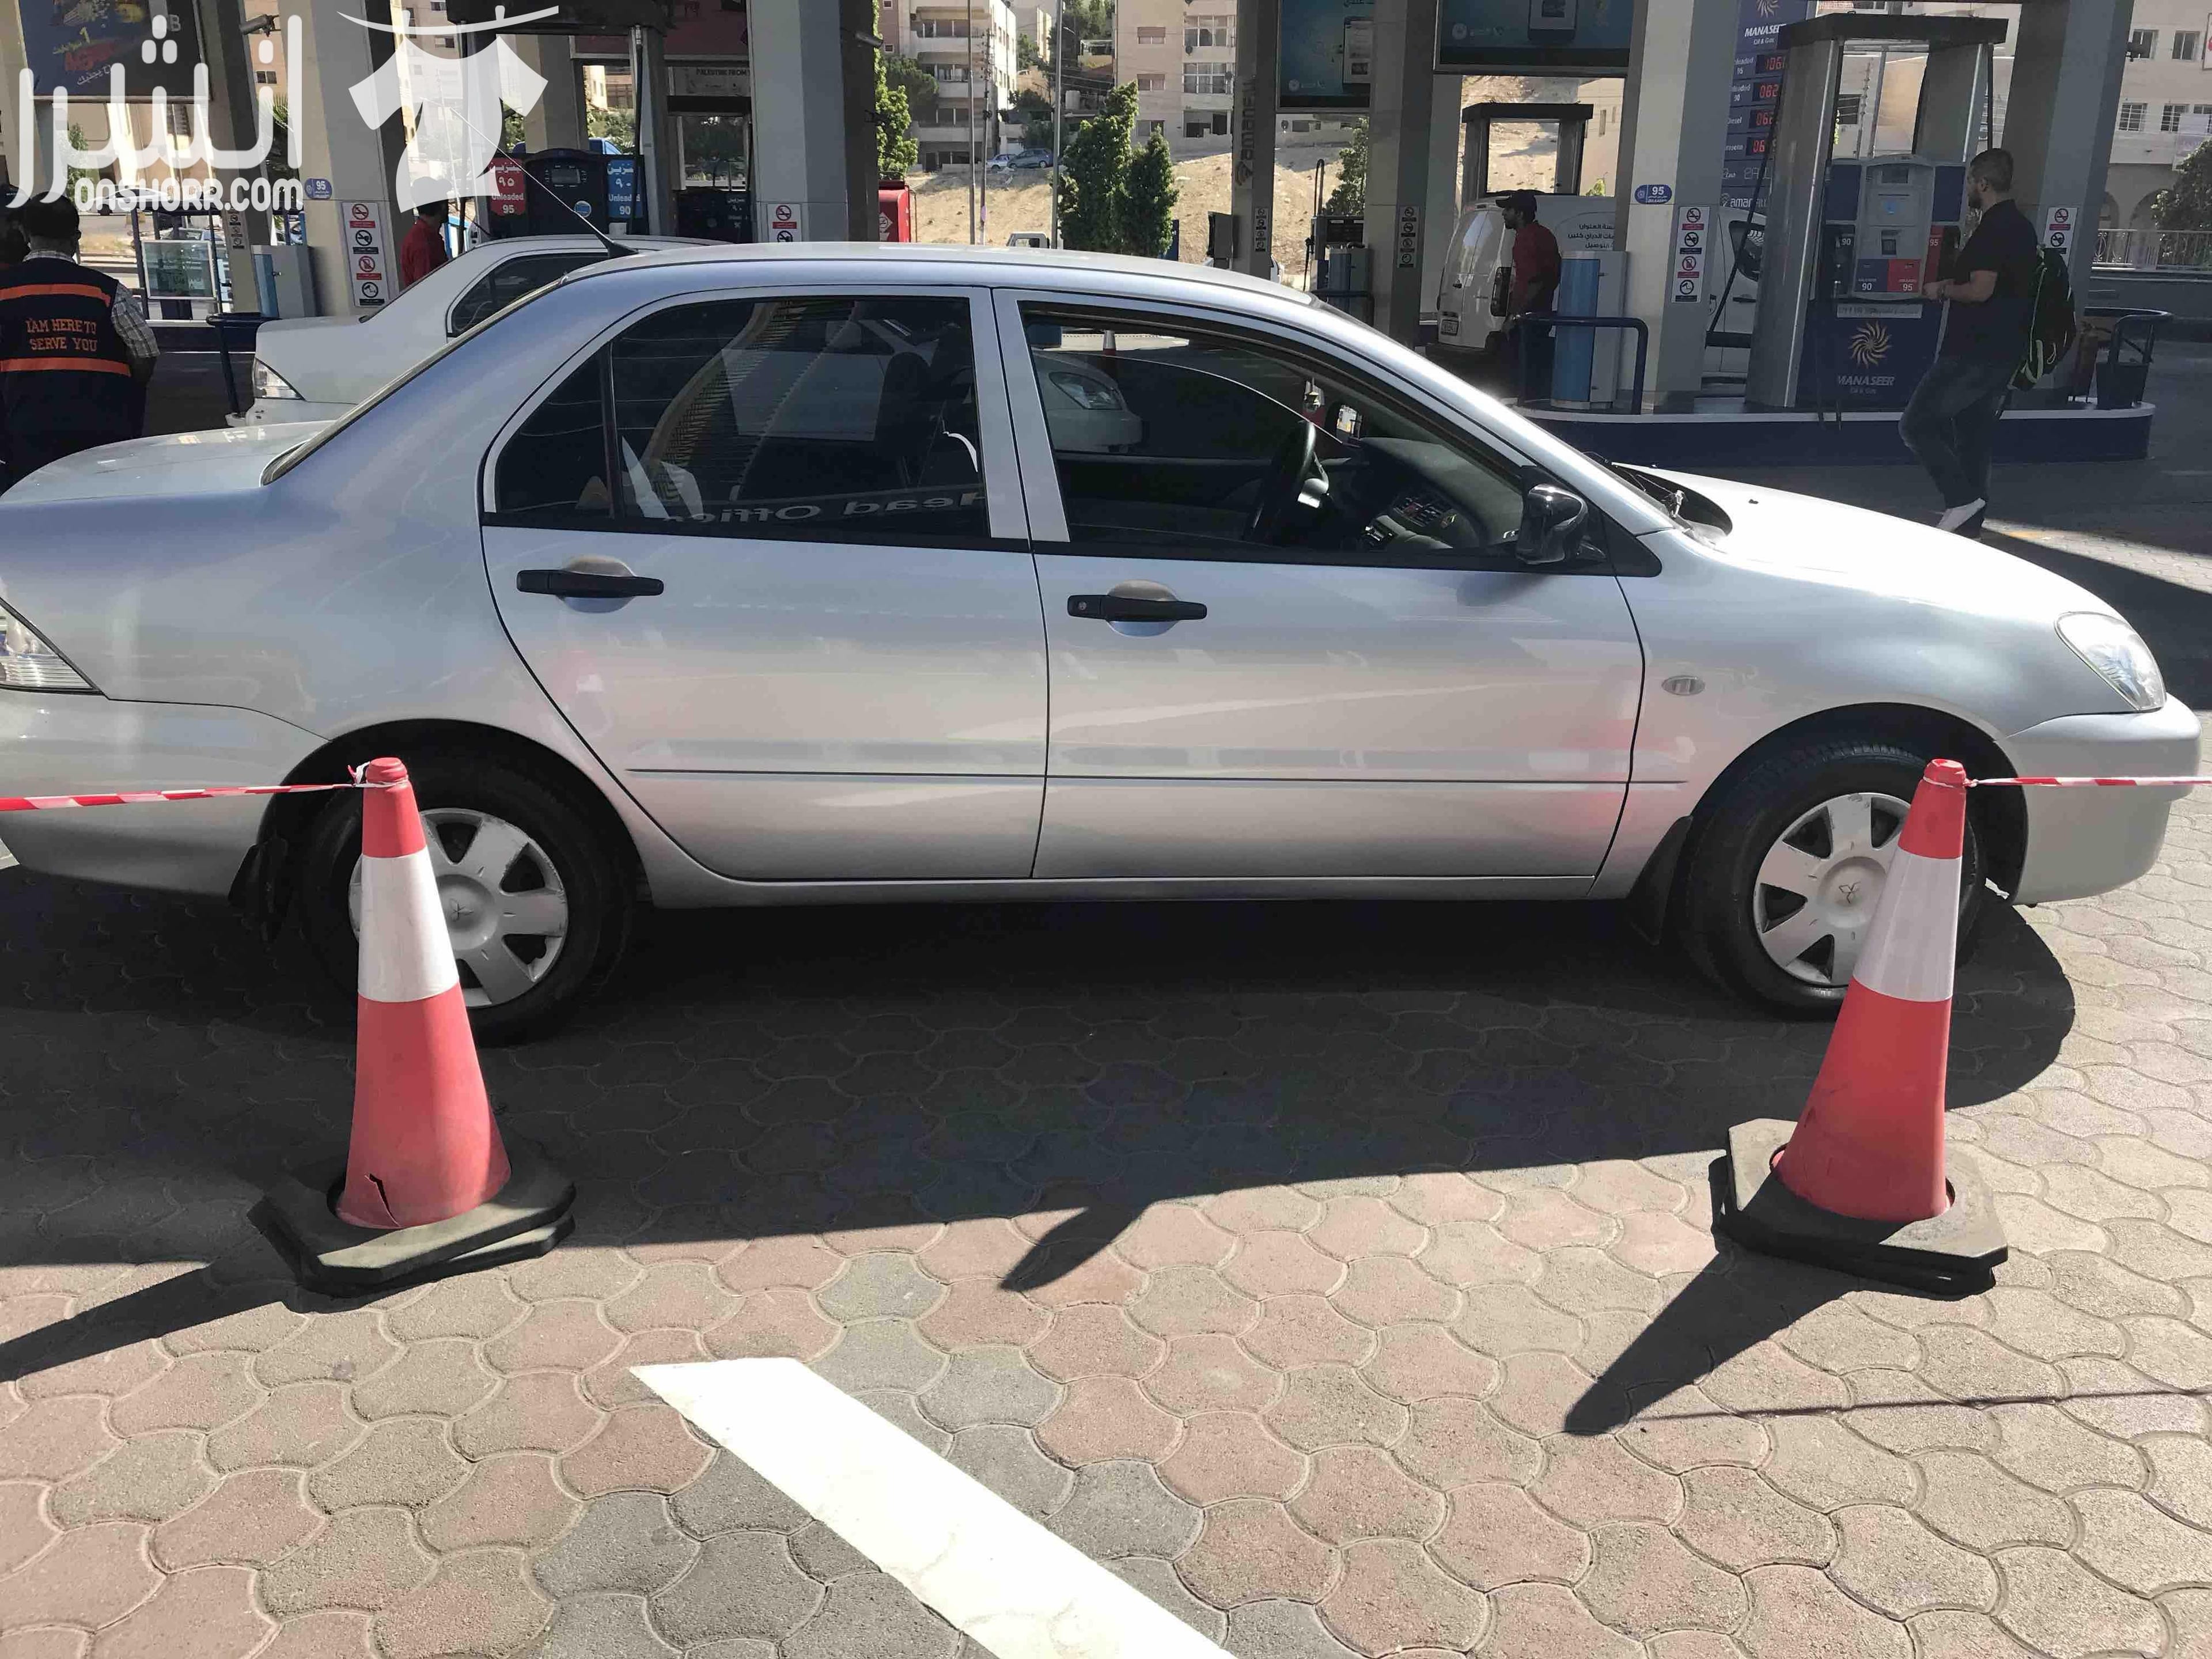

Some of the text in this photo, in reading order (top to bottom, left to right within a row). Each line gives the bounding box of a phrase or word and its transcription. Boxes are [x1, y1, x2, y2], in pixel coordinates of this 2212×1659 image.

[316, 180, 327, 191] 95
[1652, 186, 1665, 196] 95
[502, 204, 515, 214] 95
[619, 206, 631, 215] 90
[1903, 283, 1913, 291] 95
[52, 318, 83, 333] HERE
[84, 320, 97, 334] TO
[30, 336, 99, 351] SERVE YOU
